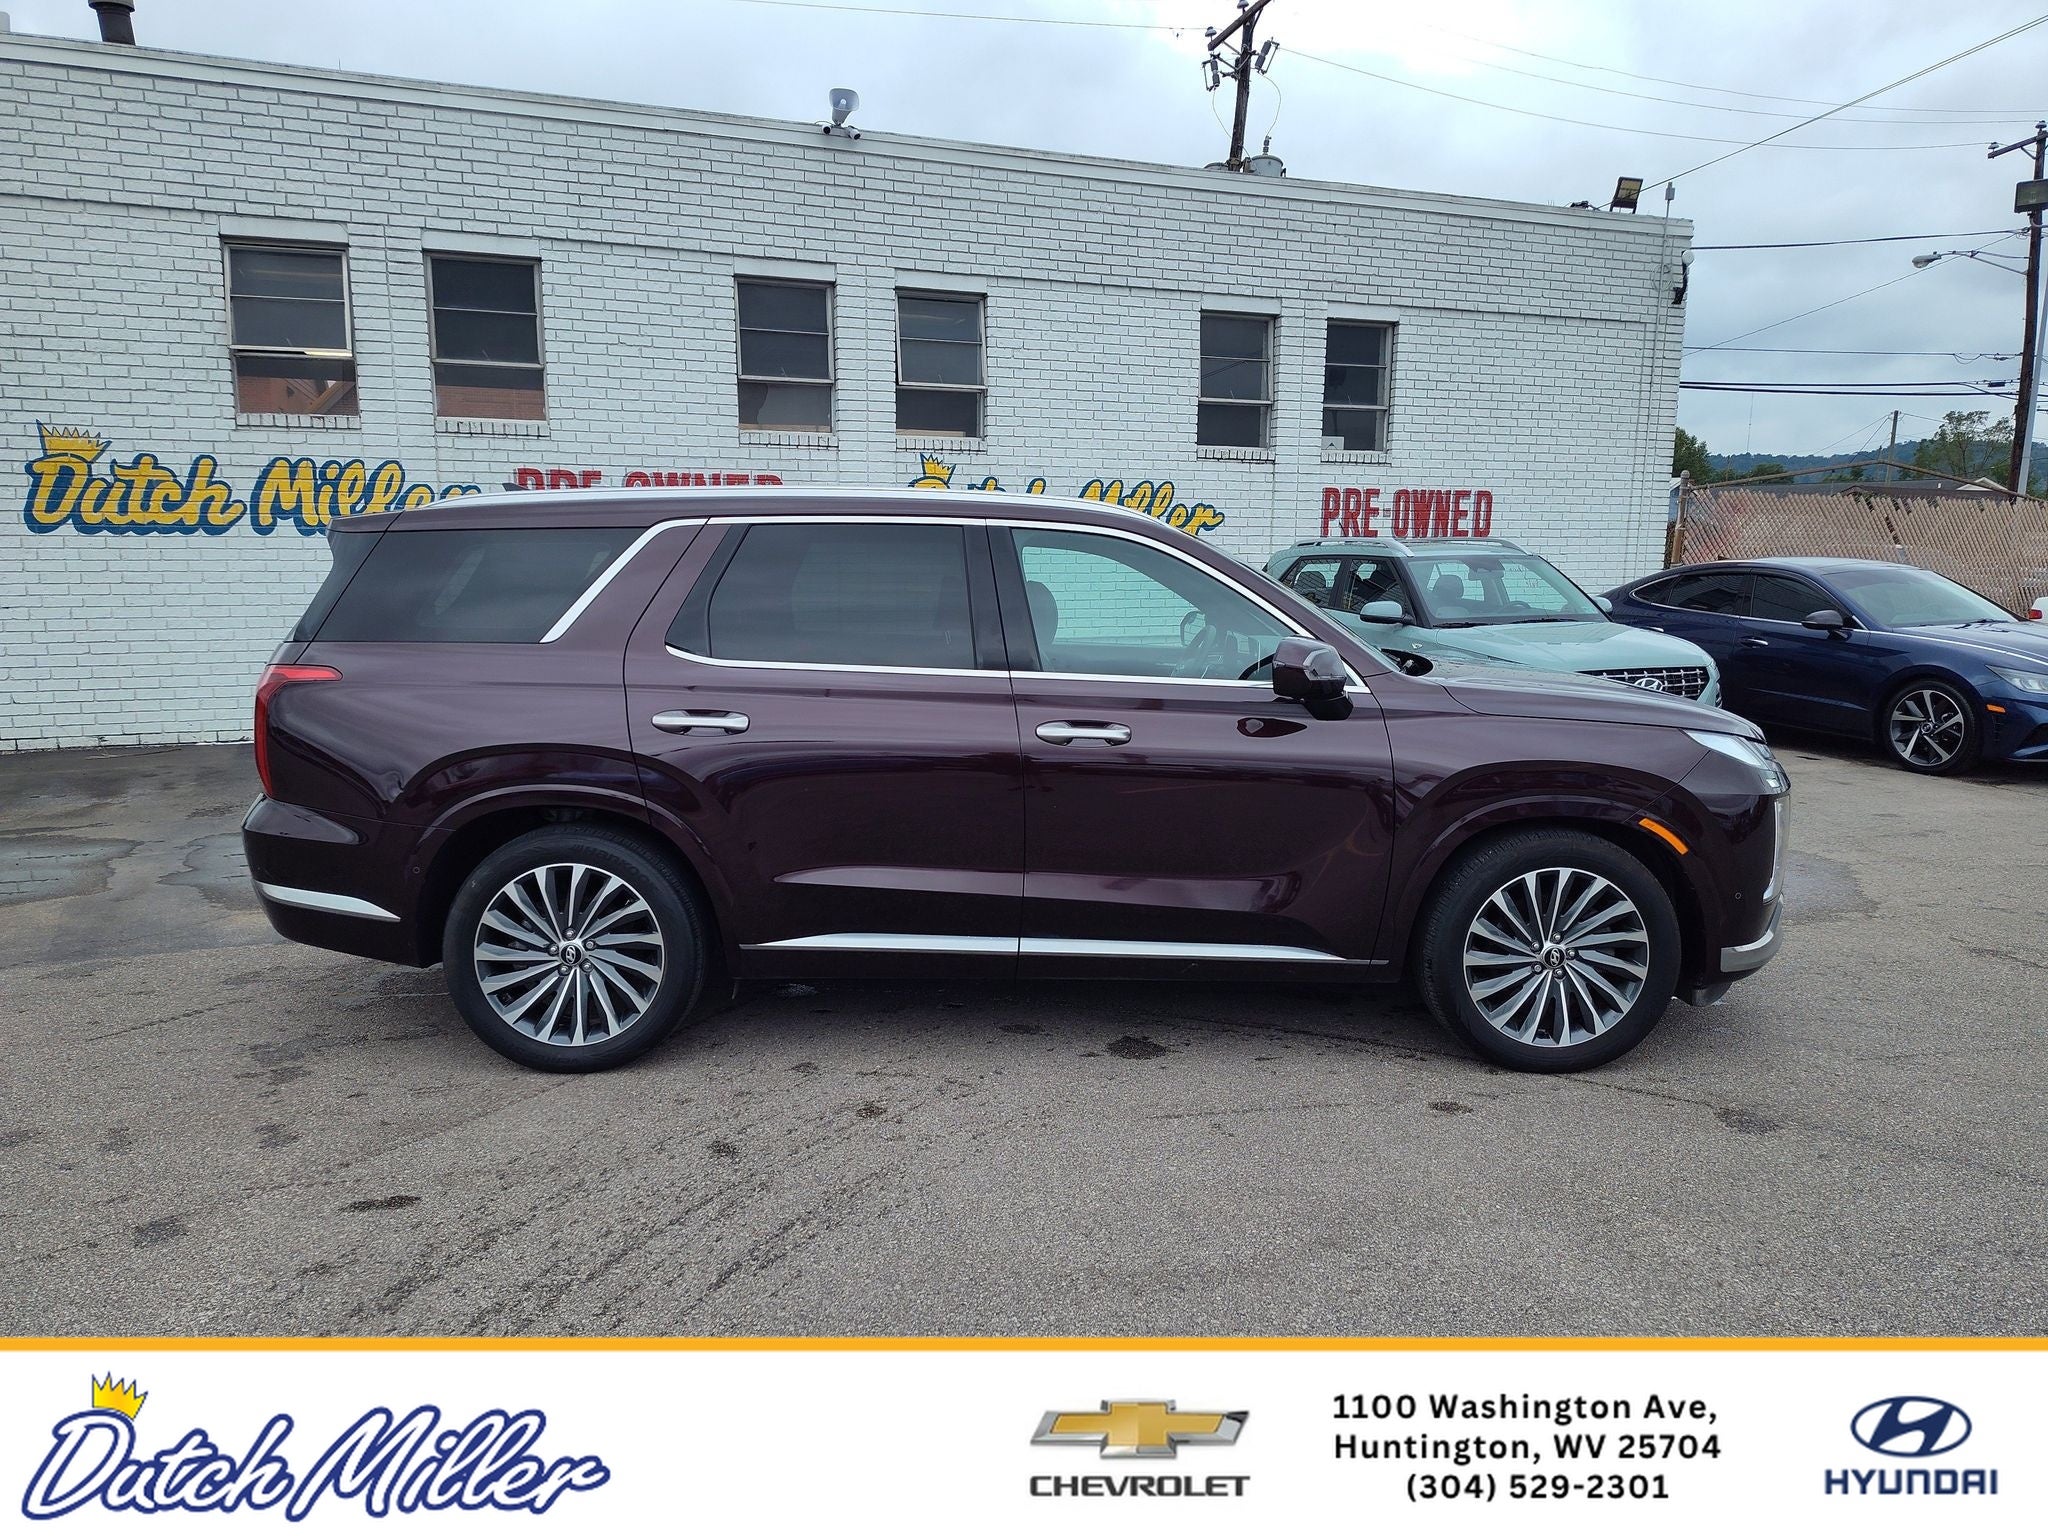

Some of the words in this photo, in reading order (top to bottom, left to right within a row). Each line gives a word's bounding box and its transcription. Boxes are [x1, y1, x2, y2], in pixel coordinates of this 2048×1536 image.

[24, 453, 248, 535] Dutch
[250, 456, 481, 536] Mille
[1320, 486, 1494, 538] PRE-OWNED
